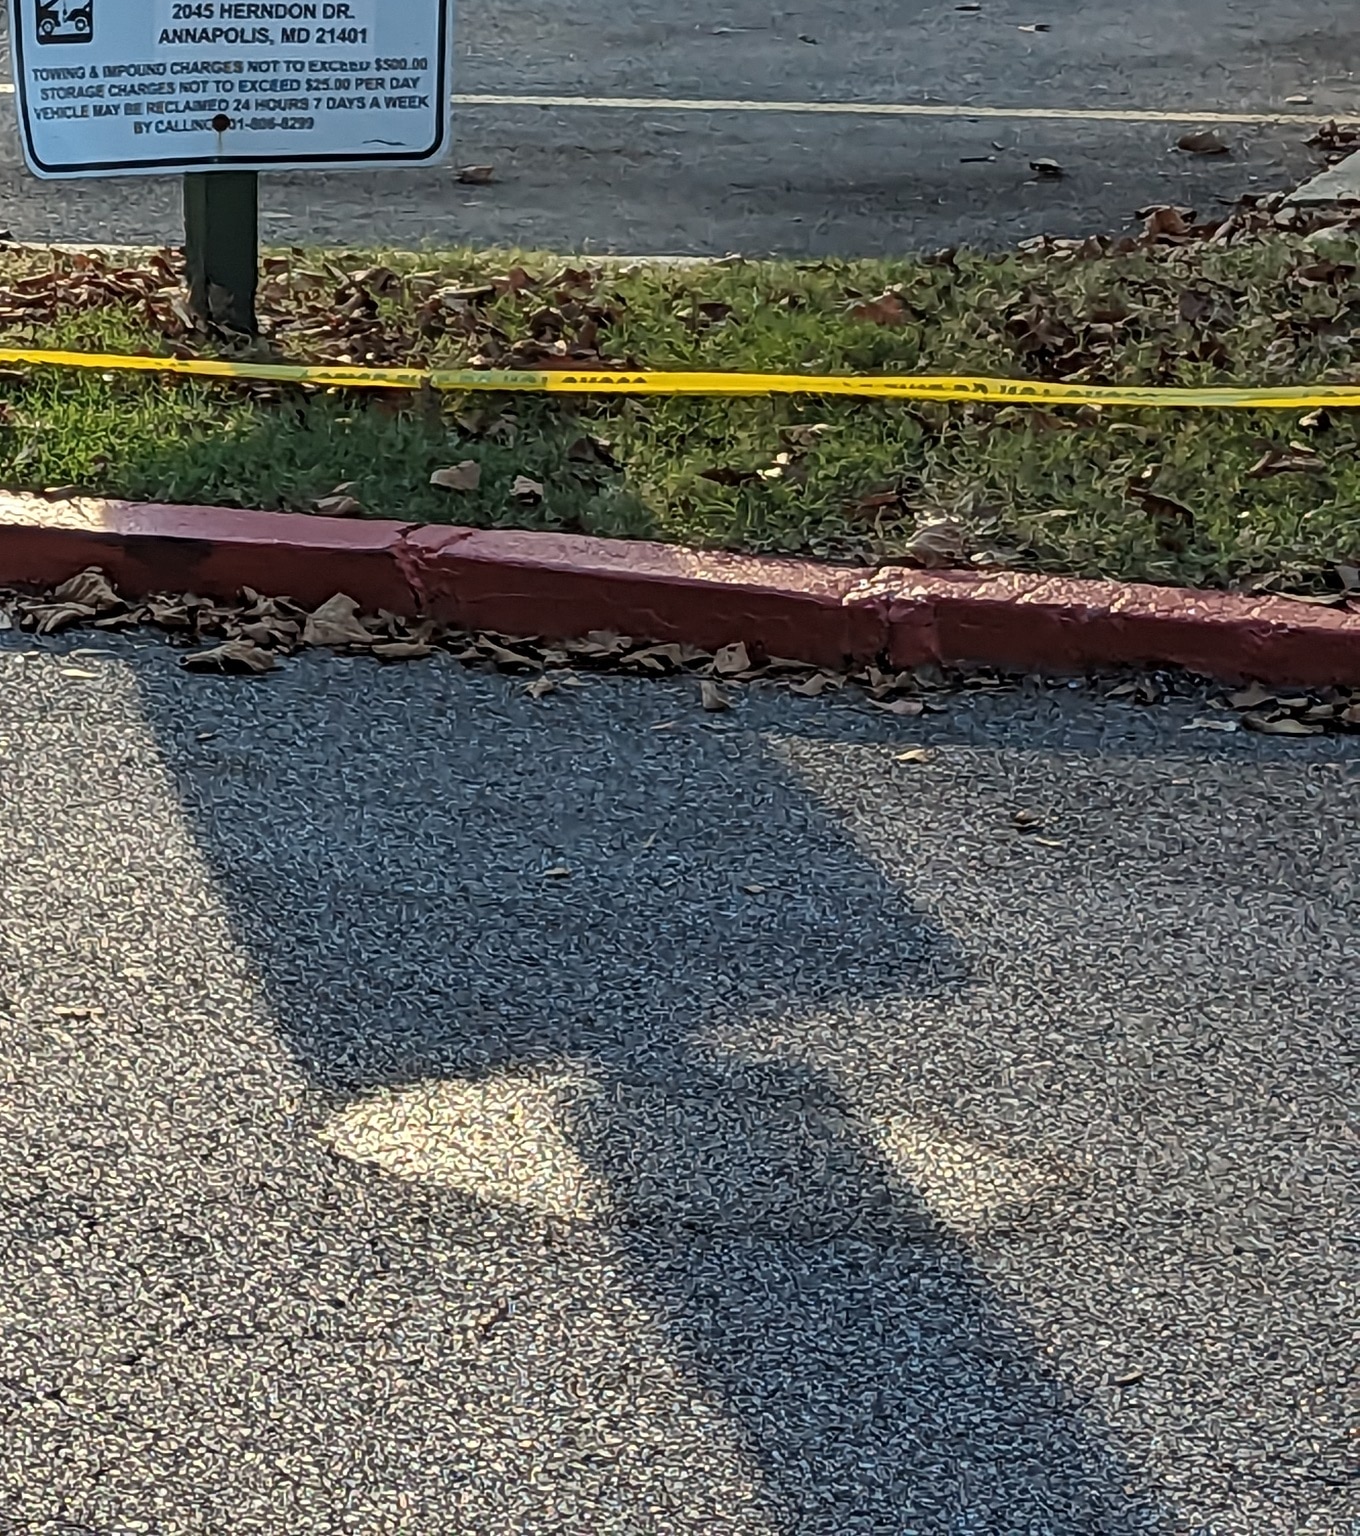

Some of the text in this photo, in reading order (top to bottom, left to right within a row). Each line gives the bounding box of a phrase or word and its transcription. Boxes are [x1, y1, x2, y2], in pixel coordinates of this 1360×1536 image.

[172, 3, 355, 19] 2045 HERNDON DR.
[158, 27, 367, 45] ANNAPOLIS, MD 21401
[32, 66, 85, 82] TOWING
[170, 61, 244, 75] CHARGES
[247, 60, 280, 73] NOT
[283, 60, 305, 73] TO
[308, 59, 371, 73] EXCEED
[40, 84, 104, 101] STORAGE
[108, 81, 175, 97] CHARGES
[179, 80, 209, 94] NOT
[214, 80, 234, 93] TO
[238, 79, 301, 93] EXCEED
[355, 77, 386, 91] PER
[390, 76, 421, 90] DAY
[34, 104, 89, 120] VEHICLE
[233, 98, 250, 112] 24
[313, 97, 322, 110] 7
[326, 96, 366, 110] DAYS
[369, 96, 383, 109] A
[384, 95, 429, 109] WEEK
[134, 120, 153, 135] BY
